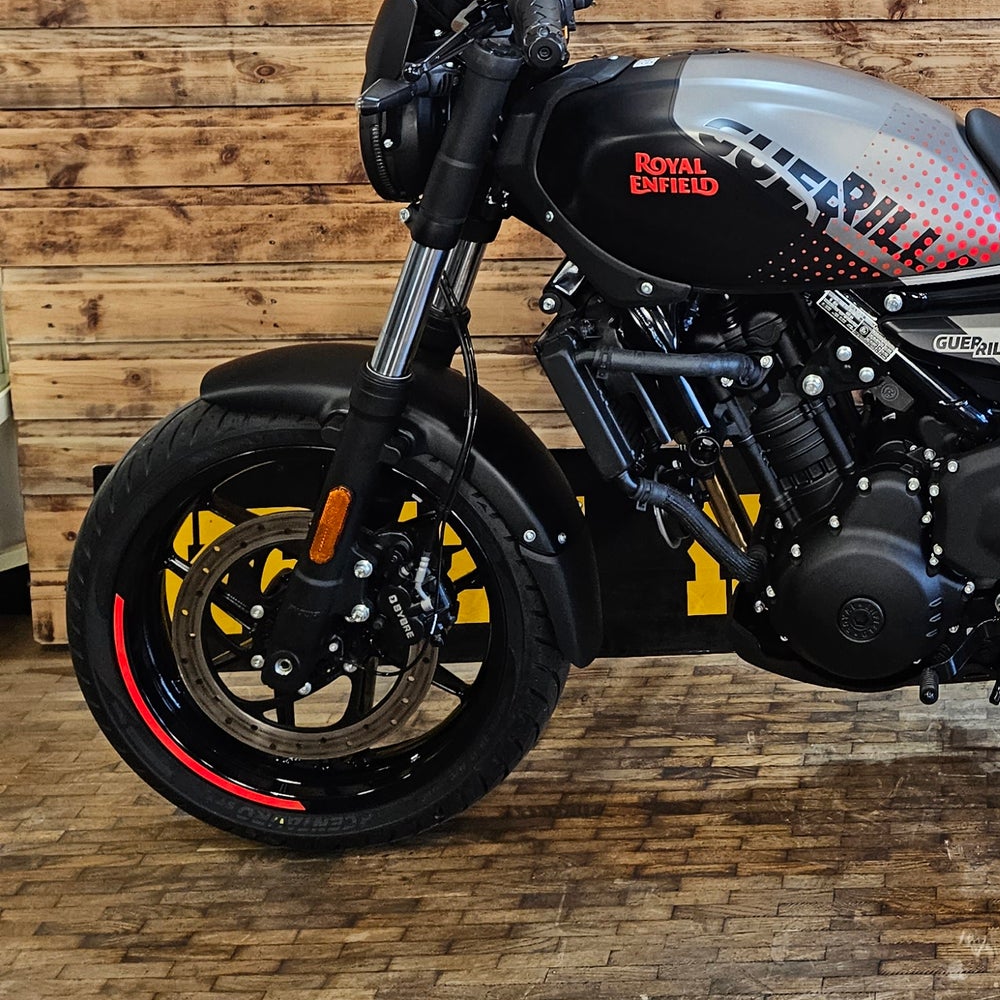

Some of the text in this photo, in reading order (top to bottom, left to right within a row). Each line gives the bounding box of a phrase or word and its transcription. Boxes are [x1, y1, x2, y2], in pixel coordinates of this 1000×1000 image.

[635, 152, 708, 176] ROYAL
[629, 174, 720, 197] ENFIELD
[393, 602, 416, 640] BYBRE
